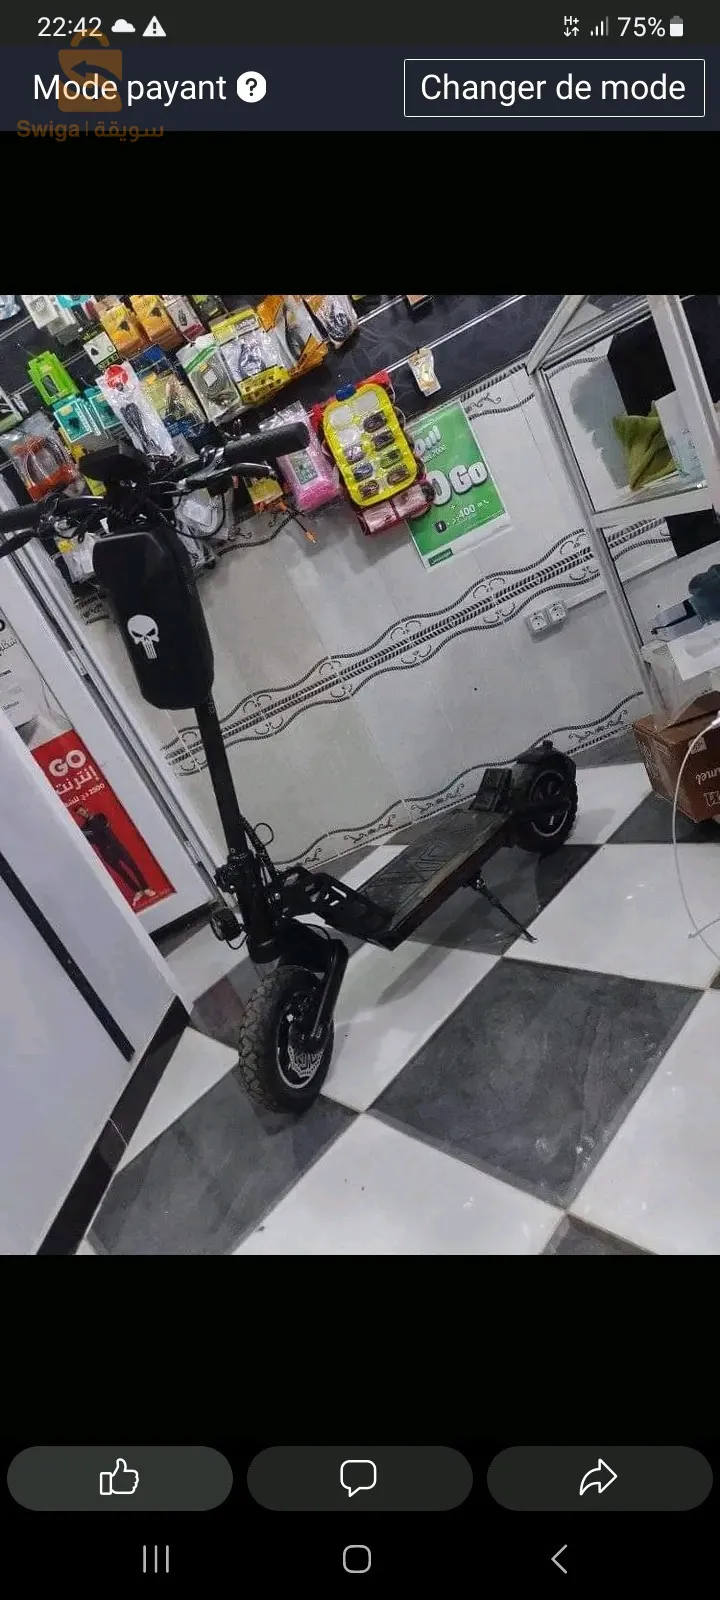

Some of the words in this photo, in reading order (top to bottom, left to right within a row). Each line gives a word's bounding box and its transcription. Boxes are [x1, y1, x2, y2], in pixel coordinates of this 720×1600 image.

[38, 17, 103, 38] 22:42
[564, 16, 579, 25] H+
[618, 17, 666, 37] 75%
[34, 73, 117, 100] Mode
[128, 76, 227, 107] payant
[421, 72, 547, 107] Changer
[556, 72, 592, 101] de
[601, 72, 686, 101] mode
[424, 461, 489, 506] 0Go
[49, 750, 86, 776] GO
